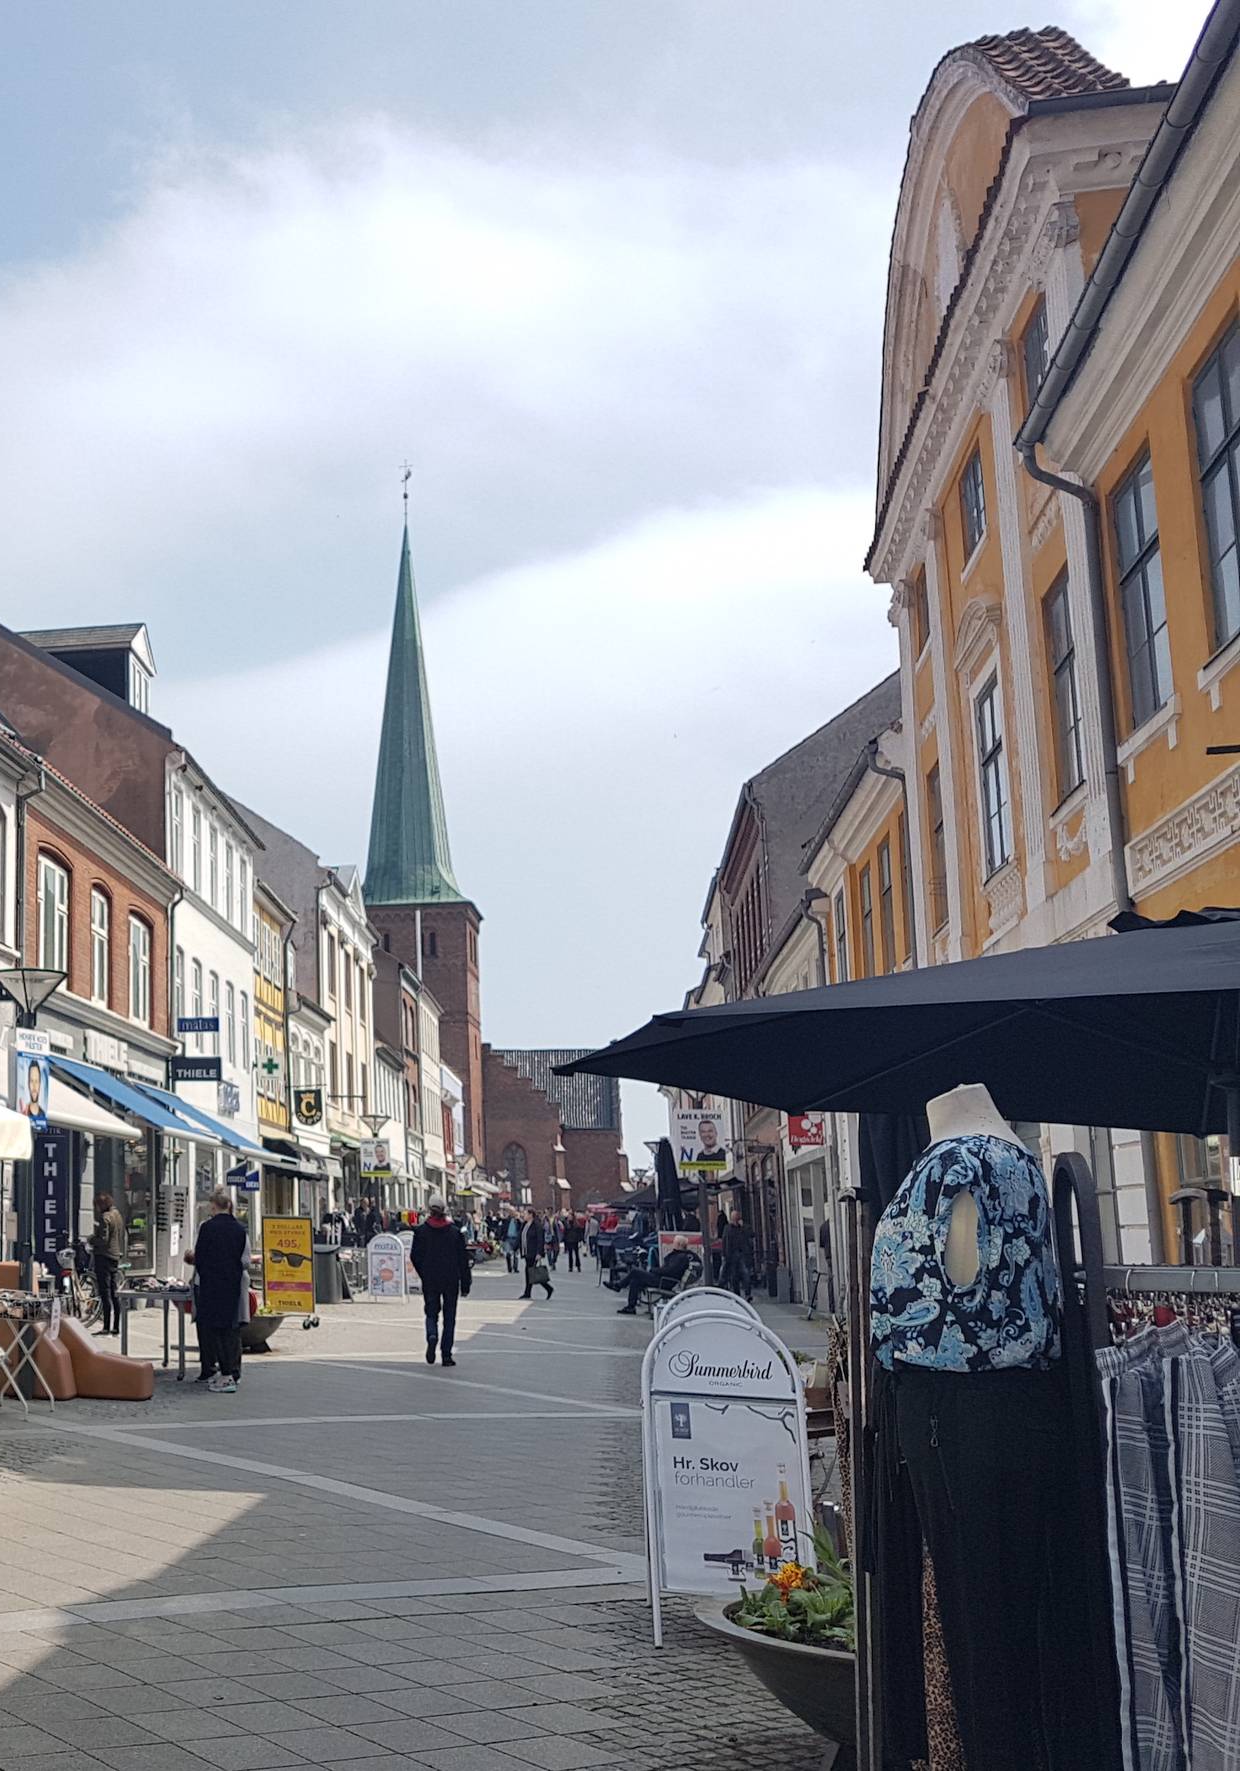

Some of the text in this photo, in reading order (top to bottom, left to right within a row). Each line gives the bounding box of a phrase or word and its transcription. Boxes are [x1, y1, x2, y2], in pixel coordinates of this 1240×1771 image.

[181, 1019, 215, 1031] matas
[175, 1068, 218, 1078] THIELE
[680, 1145, 694, 1162] N
[43, 1142, 58, 1253] THIELE
[374, 1242, 398, 1251] matas
[668, 1350, 773, 1381] Summerbird
[708, 1380, 743, 1388] ORGANIC
[673, 1456, 740, 1472] Hr. Skov
[674, 1470, 757, 1489] forhandler
